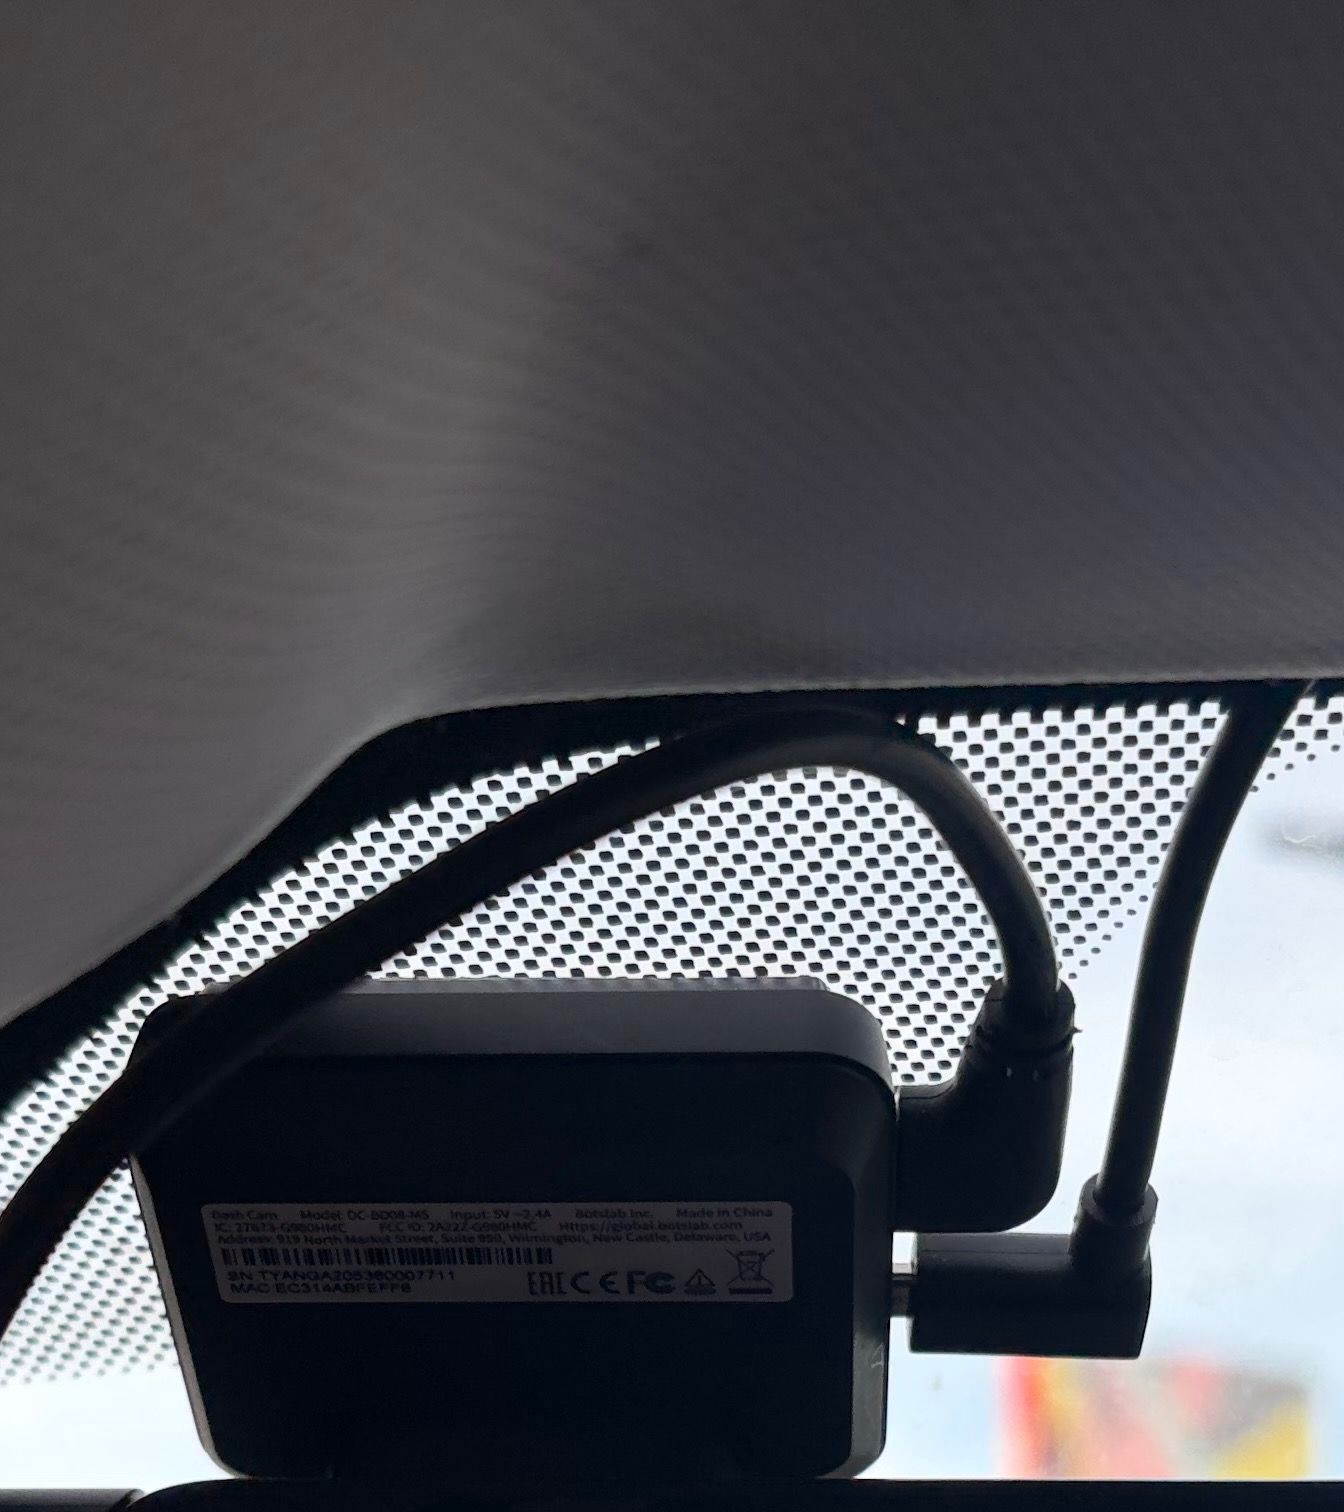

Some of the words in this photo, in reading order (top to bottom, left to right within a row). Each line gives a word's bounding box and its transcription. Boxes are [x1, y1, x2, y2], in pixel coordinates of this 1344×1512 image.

[247, 1210, 278, 1220] Cam
[450, 1209, 491, 1222] Input:
[575, 1208, 627, 1219] Botslab
[630, 1208, 654, 1218] Inc.
[676, 1207, 714, 1218] Made
[717, 1208, 730, 1218] in
[733, 1207, 773, 1218] China
[378, 1221, 405, 1232] FCC
[304, 1234, 343, 1245] North
[440, 1233, 475, 1243] Suite
[592, 1233, 623, 1243] New
[625, 1232, 672, 1244] Castle,
[743, 1231, 772, 1241] USA
